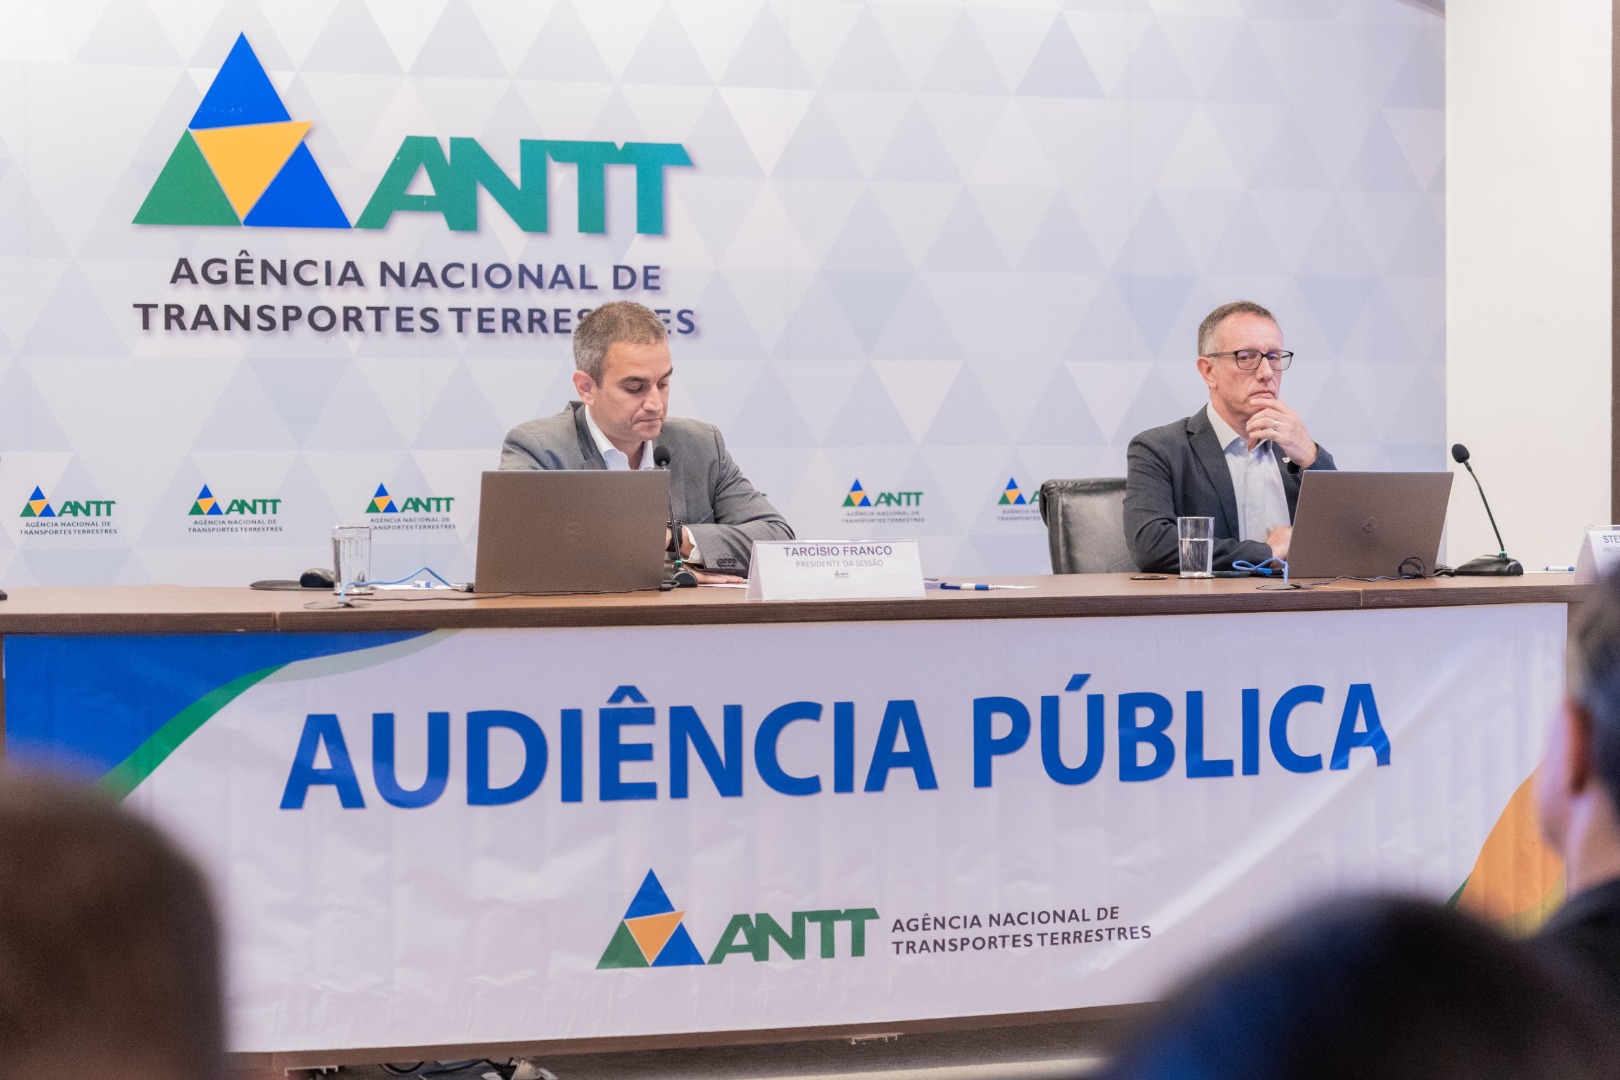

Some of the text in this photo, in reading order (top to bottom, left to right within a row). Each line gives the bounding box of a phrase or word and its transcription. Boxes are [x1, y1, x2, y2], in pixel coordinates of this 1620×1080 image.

[353, 136, 693, 234] ANTT
[170, 250, 661, 291] AGÊNCIA NACIONAL DE
[133, 303, 440, 332] TRANSPORTES
[57, 500, 116, 517] ANTT
[224, 499, 282, 515] ANTT
[400, 497, 455, 513] ANTT
[874, 492, 923, 507] ANTT
[783, 544, 893, 557] TARCÍSIO FRANCO
[796, 560, 841, 568] PRESIDENTE
[855, 558, 884, 567] SESSÃO
[279, 673, 1391, 810] AUDIÊNCIA PÚBLICA
[891, 906, 1120, 933] AGÊNCIA NACIONAL DE
[707, 907, 880, 965] ANTT
[891, 925, 1152, 955] TRANSPORTES TERRESTRES
